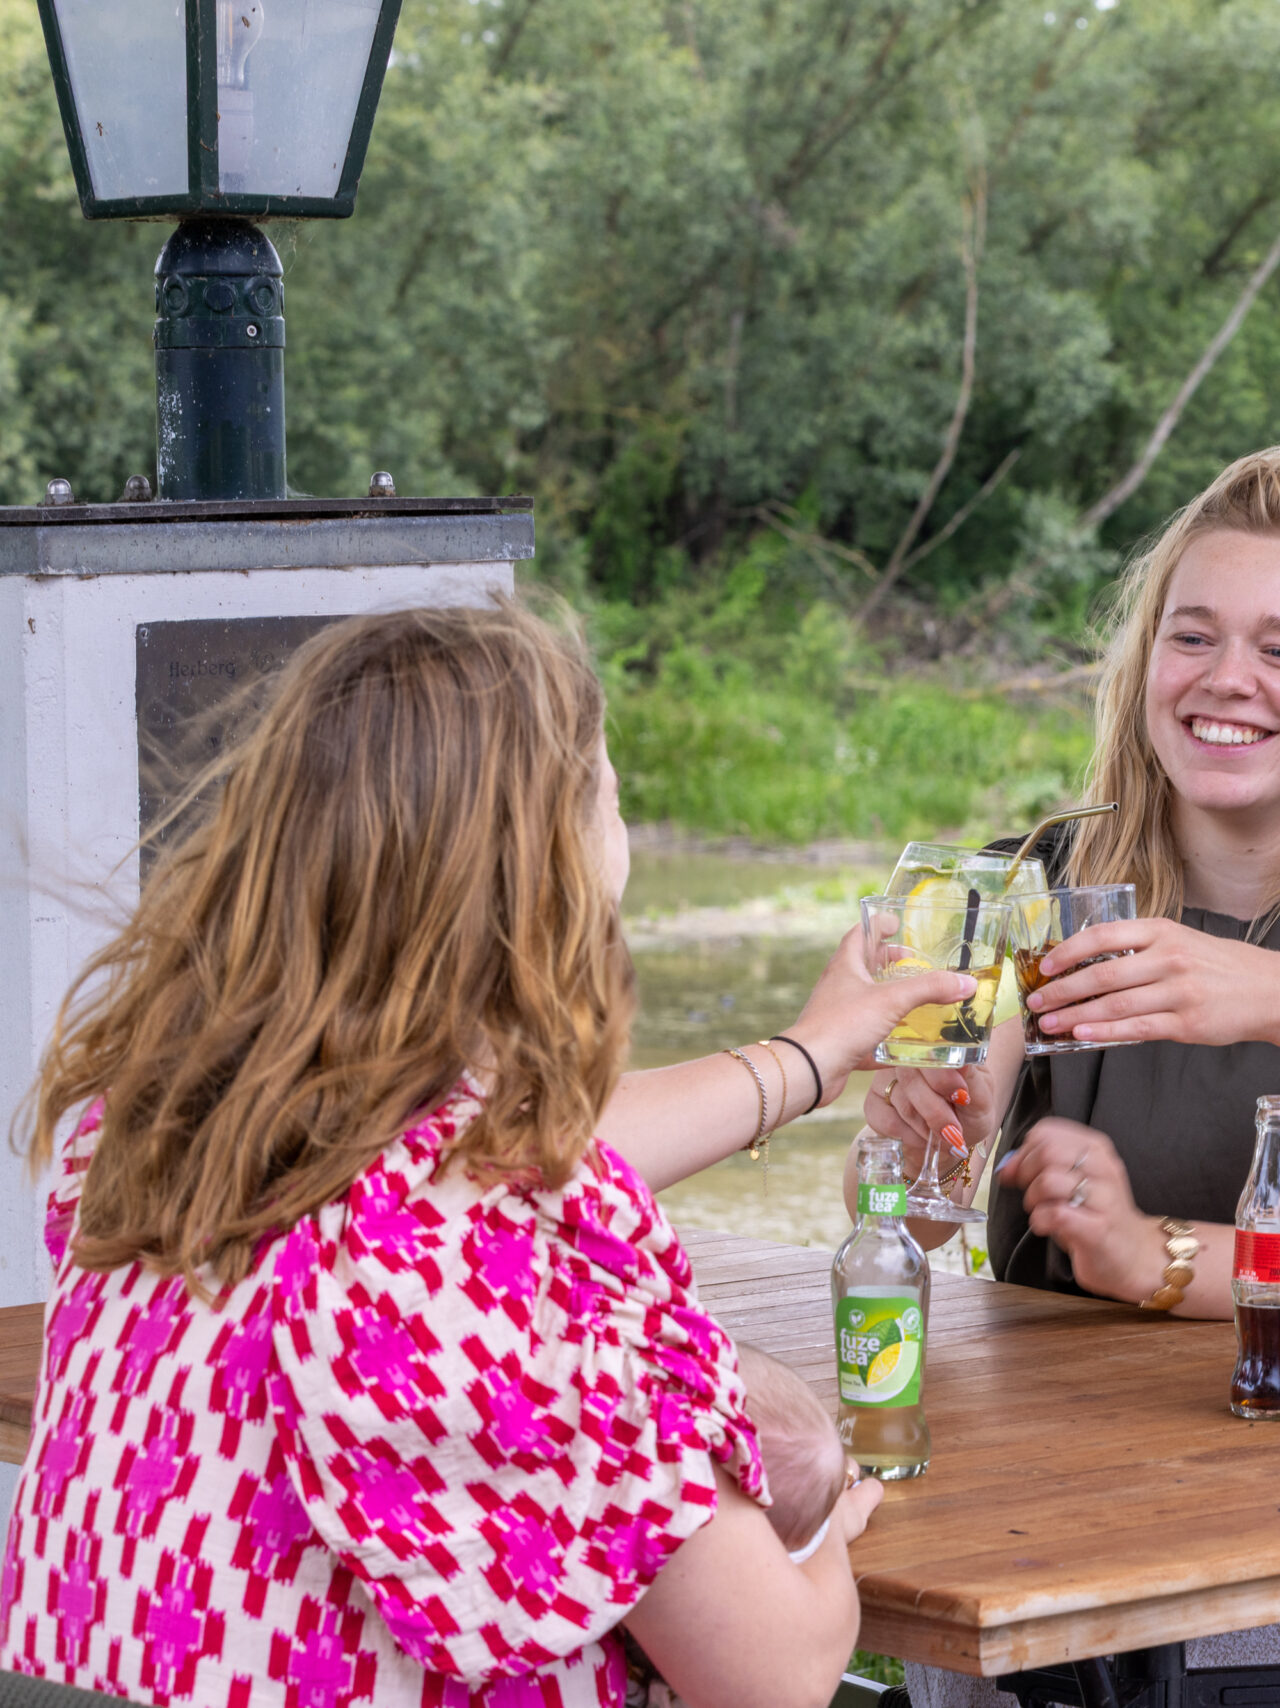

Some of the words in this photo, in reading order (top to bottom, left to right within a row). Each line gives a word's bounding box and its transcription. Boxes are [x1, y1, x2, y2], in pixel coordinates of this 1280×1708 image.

[169, 661, 236, 679] Herberg
[869, 1187, 899, 1202] fuze
[869, 1200, 892, 1212] tea
[840, 1328, 880, 1352] fuze
[841, 1348, 868, 1366] tea
